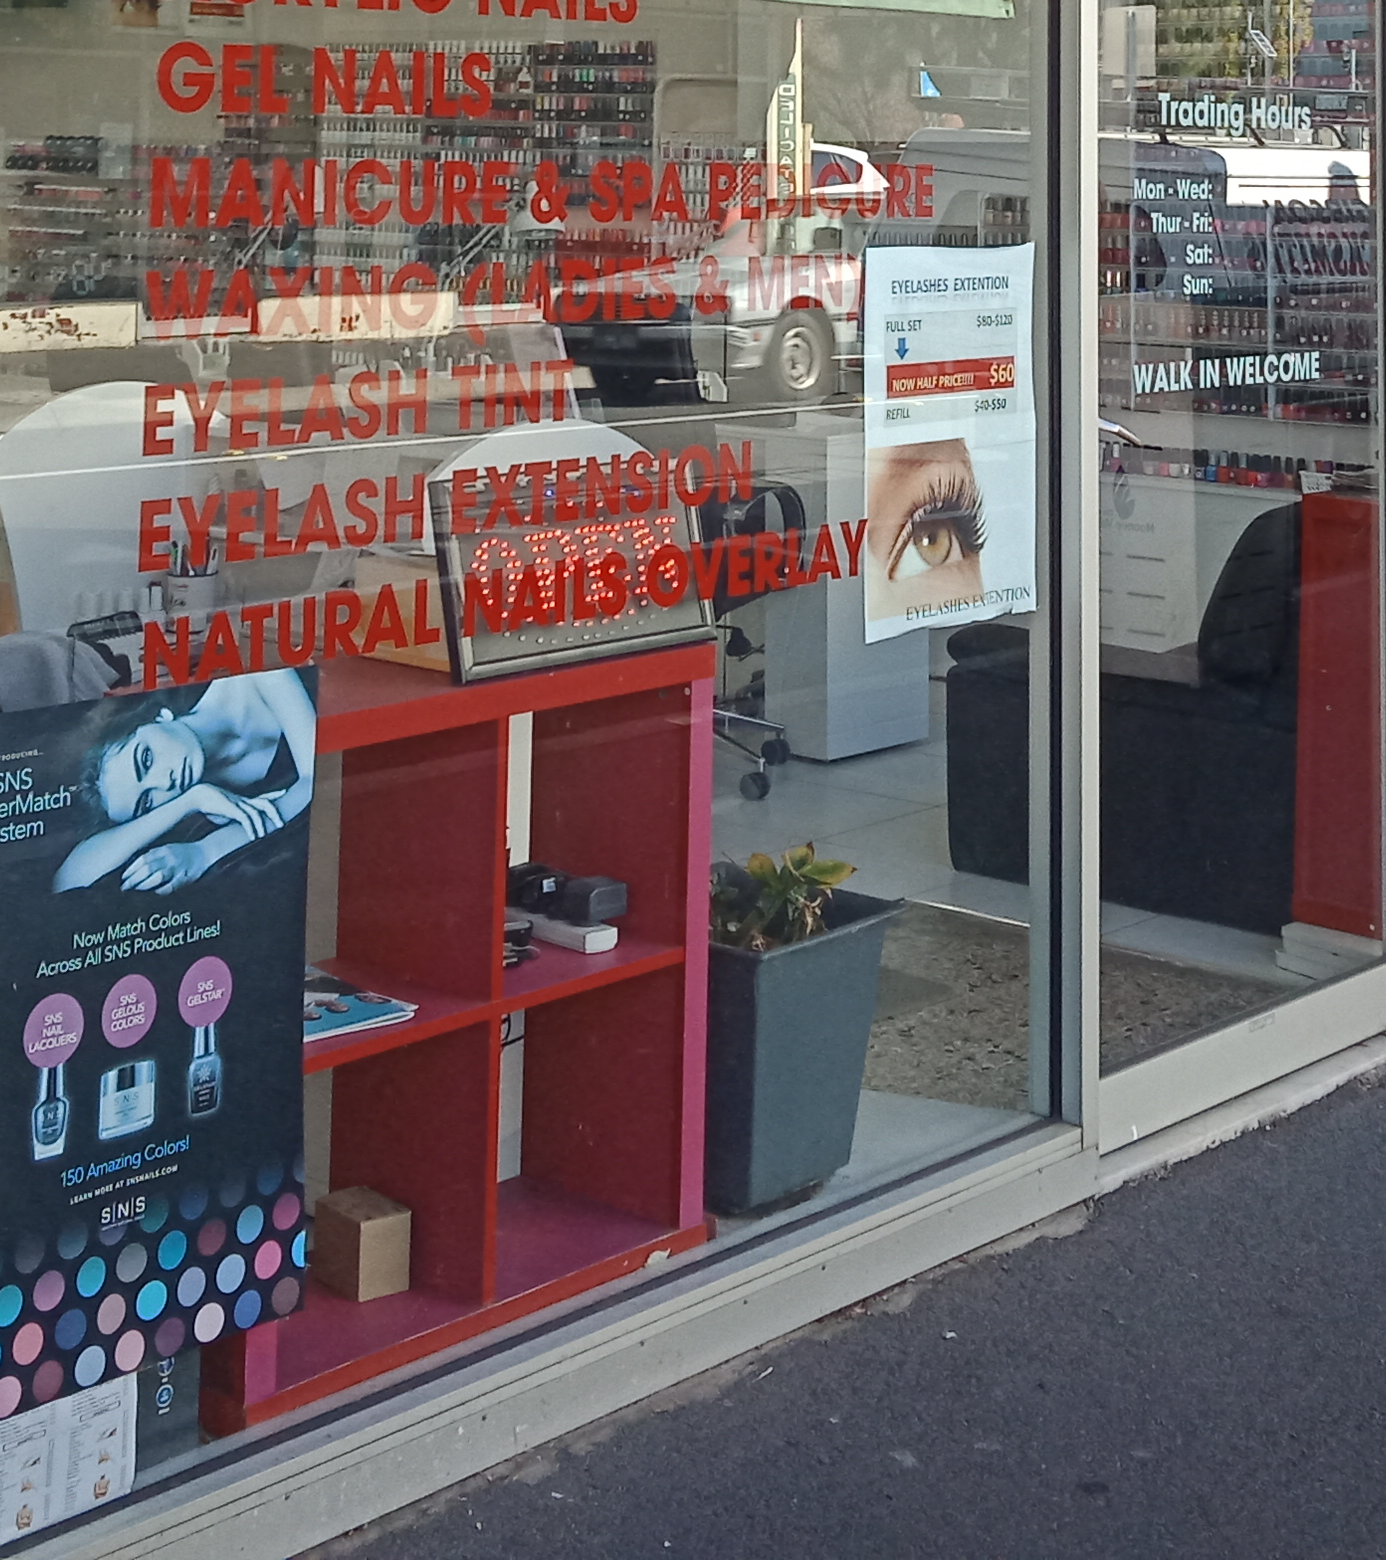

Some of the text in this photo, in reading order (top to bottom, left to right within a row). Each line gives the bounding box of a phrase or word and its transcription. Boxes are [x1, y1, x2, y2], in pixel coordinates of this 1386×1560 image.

[156, 42, 493, 120] GEL NAILS
[1158, 92, 1311, 137] Trading Hours
[149, 157, 934, 230] MANICURE & SPA PEDICURE
[1133, 178, 1214, 200] Mon Wed:
[1150, 212, 1183, 235] Thur
[1185, 244, 1214, 266] Sat:
[891, 276, 1009, 296] EYELASHES EXTENTION
[1182, 274, 1214, 296] Sun:
[145, 262, 439, 340] WAXING
[695, 255, 730, 315] &
[886, 318, 922, 333] FULL SET
[892, 376, 915, 392] NOW
[917, 374, 937, 390] HALF
[989, 362, 1014, 386] $60
[1133, 351, 1321, 395] WALK IN WELCOME
[142, 359, 574, 457] EYELASH TINT
[886, 407, 911, 421] REFILL
[139, 441, 753, 573] EYELASH EXTENSION
[140, 518, 869, 690] NATURAL NAILS OVERLAY
[906, 597, 971, 622] EYELASHES
[72, 910, 191, 950] Now Match Colors
[36, 920, 221, 979] Across All SNS Product Lines!
[197, 979, 214, 992] SNS
[119, 991, 137, 1007] SNS
[44, 1011, 63, 1027] SNS
[111, 1001, 145, 1021] GELOUS
[42, 1024, 64, 1038] NAIL
[110, 1014, 146, 1032] COLORS
[28, 1034, 78, 1054] LACQUERS
[60, 1134, 191, 1188] 150 Amazing Colors!
[69, 1191, 93, 1206] LEARN
